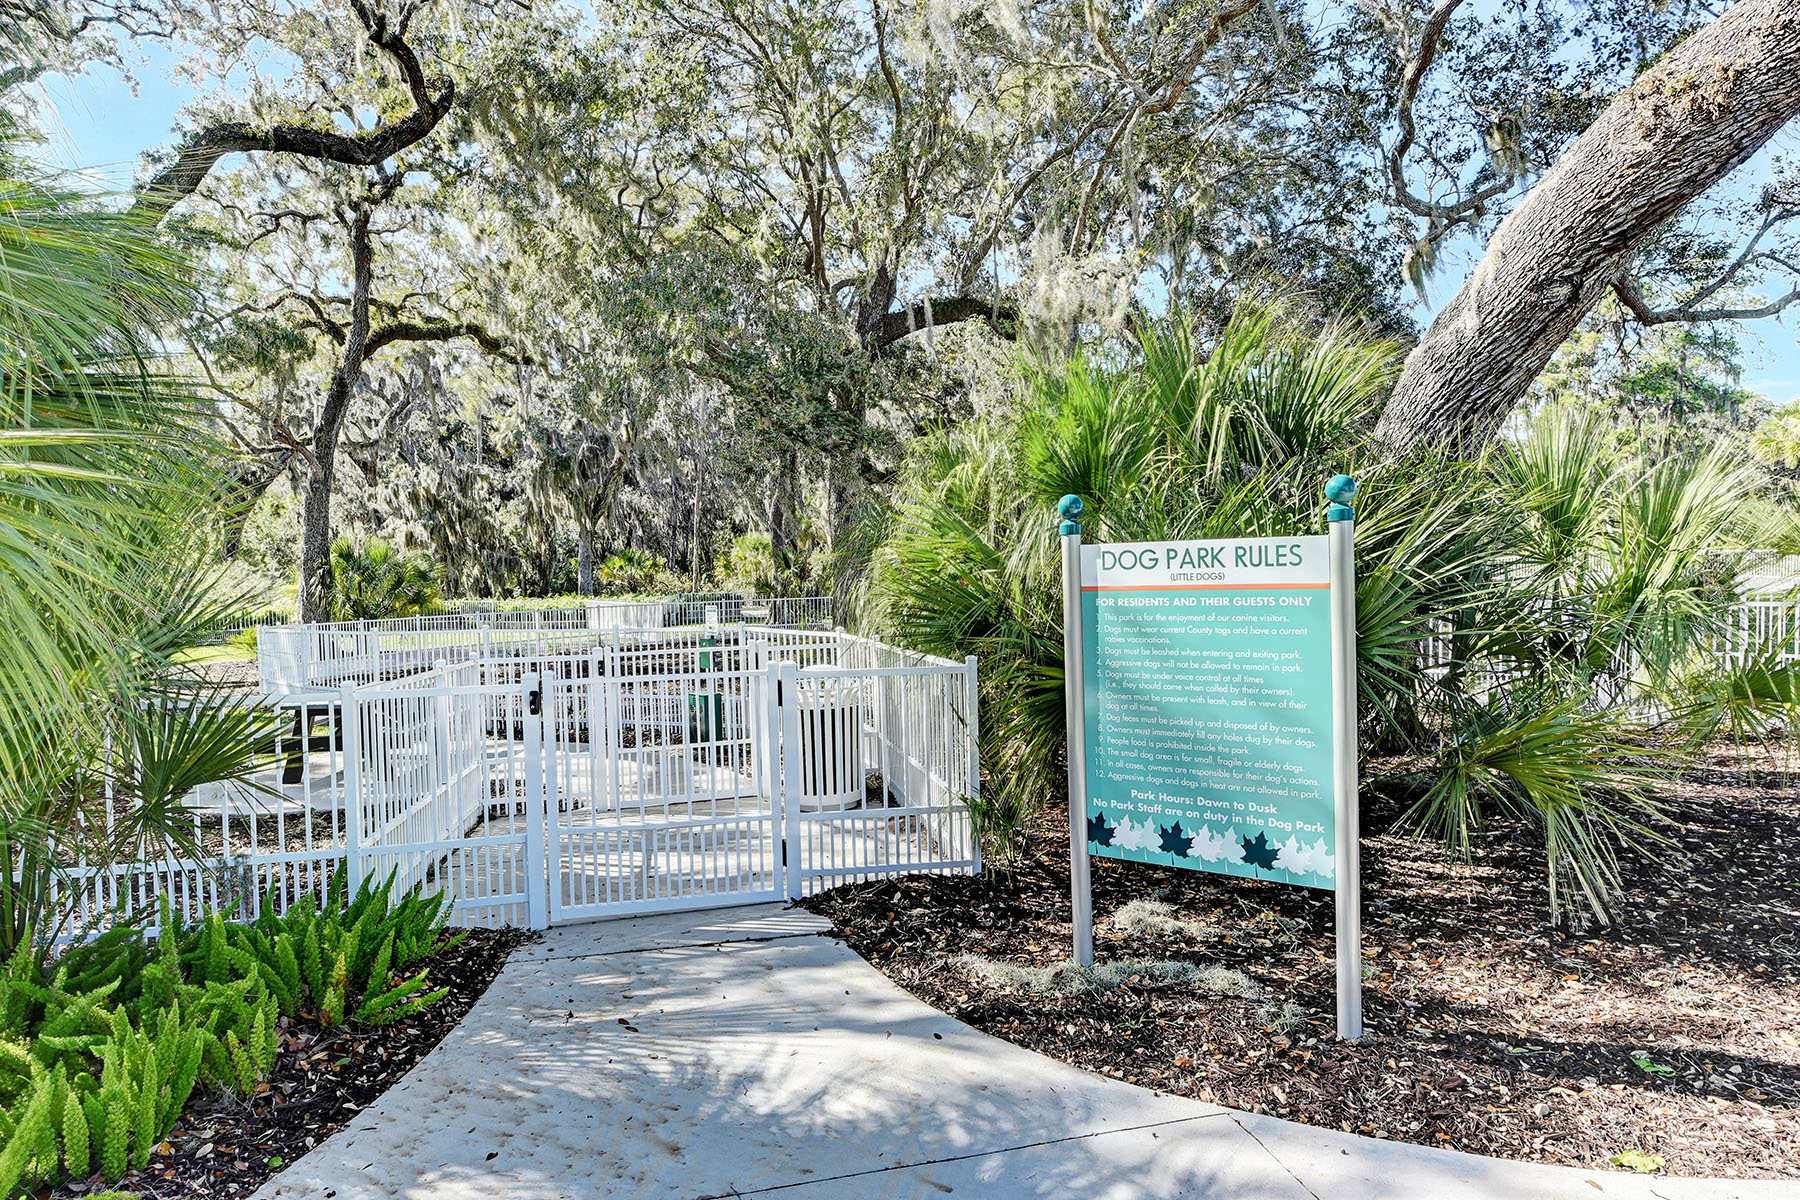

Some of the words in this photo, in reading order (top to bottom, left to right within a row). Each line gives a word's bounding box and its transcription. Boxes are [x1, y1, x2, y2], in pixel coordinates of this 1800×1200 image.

[1101, 548, 1159, 570] DOG
[1166, 546, 1226, 569] PARK
[1234, 544, 1302, 567] RULES
[1170, 572, 1194, 581] (LITTLE
[1195, 571, 1225, 581] DOGS)
[1095, 597, 1114, 606] FOR
[1117, 597, 1170, 606] RESIDENTS
[1172, 597, 1197, 606] AND
[1199, 597, 1230, 606] THEIR
[1232, 597, 1275, 606] GUESTS
[1278, 597, 1312, 606] ONLY
[1104, 612, 1117, 620] This
[1118, 612, 1135, 623] park
[1143, 612, 1154, 620] for
[1155, 612, 1167, 621] the
[1167, 613, 1206, 623] enjoyment
[1207, 613, 1215, 621] of
[1104, 624, 1121, 634] Dogs
[1186, 625, 1213, 636] County
[1214, 627, 1230, 636] tags
[1232, 625, 1248, 634] and
[1249, 626, 1269, 634] have
[1104, 634, 1125, 642] rabies
[1126, 635, 1170, 643] vaccinations.
[1104, 646, 1121, 656] Dogs
[1140, 646, 1150, 655] be
[1151, 647, 1179, 655] leashed
[1180, 648, 1200, 656] when
[1202, 649, 1233, 659] entering
[1234, 649, 1250, 657] and
[1252, 650, 1278, 660] exiting
[1281, 650, 1301, 661] park.
[1104, 657, 1142, 667] Aggressive
[1143, 658, 1160, 669] dogs
[1162, 659, 1174, 667] will
[1189, 660, 1199, 668] be
[1201, 660, 1231, 669] allowed
[1242, 663, 1269, 671] remain
[1272, 663, 1279, 671] in
[1281, 663, 1302, 673] park.
[1104, 669, 1122, 680] Dogs
[1141, 670, 1150, 679] be
[1152, 671, 1172, 679] under
[1174, 672, 1193, 680] voice
[1195, 673, 1220, 681] control
[1231, 674, 1241, 682] all
[1243, 675, 1264, 683] times
[1122, 679, 1137, 690] they
[1138, 680, 1161, 689] should
[1183, 682, 1203, 691] when
[1205, 683, 1228, 692] called
[1229, 684, 1240, 695] by
[1241, 685, 1259, 694] their
[1106, 691, 1132, 700] Owners
[1150, 692, 1160, 701] be
[1161, 696, 1188, 704] present
[1189, 695, 1205, 703] with
[1207, 695, 1229, 706] leash,
[1231, 697, 1246, 706] and
[1248, 698, 1256, 706] in
[1257, 699, 1277, 707] view
[1278, 699, 1287, 708] of
[1288, 700, 1307, 709] their
[1106, 700, 1119, 711] dog
[1129, 702, 1137, 710] all
[1139, 703, 1159, 712] times.
[1106, 712, 1120, 723] Dog
[1122, 713, 1139, 722] feces
[1158, 715, 1168, 724] be
[1169, 717, 1193, 727] picked
[1194, 720, 1204, 729] up
[1206, 719, 1221, 727] and
[1223, 719, 1257, 731] disposed
[1259, 722, 1267, 730] of
[1269, 722, 1280, 734] by
[1106, 724, 1133, 733] Owners
[1151, 727, 1195, 740] immediately
[1196, 730, 1205, 739] fill
[1206, 733, 1221, 742] any
[1223, 732, 1243, 741] holes
[1244, 733, 1260, 745] dug
[1262, 734, 1273, 746] by
[1274, 736, 1293, 745] their
[1294, 737, 1317, 748] dogs.
[1106, 735, 1129, 746] People
[1130, 736, 1146, 746] food
[1148, 738, 1154, 746] is
[1155, 739, 1192, 750] prohibited
[1194, 742, 1216, 752] inside
[1217, 744, 1229, 753] the
[1107, 747, 1119, 755] The
[1120, 749, 1138, 757] small
[1139, 749, 1153, 761] dog
[1173, 753, 1180, 761] is
[1181, 753, 1192, 762] for
[1193, 755, 1215, 765] small,
[1217, 756, 1242, 768] fragile
[1254, 759, 1281, 772] elderly
[1114, 759, 1123, 767] all
[1125, 762, 1146, 771] cases,
[1147, 764, 1173, 772] owners
[1188, 768, 1230, 778] responsible
[1232, 770, 1243, 779] for
[1245, 771, 1263, 781] their
[1288, 777, 1320, 786] actions.
[1107, 770, 1144, 781] Aggressive
[1145, 773, 1163, 785] dogs
[1164, 776, 1179, 785] and
[1180, 777, 1198, 788] dogs
[1200, 779, 1207, 787] in
[1209, 779, 1226, 789] heat
[1257, 785, 1288, 796] allowed
[1290, 788, 1298, 796] in
[1300, 790, 1321, 800] park.
[1130, 789, 1155, 800] Park
[1158, 792, 1193, 804] Hours:
[1196, 796, 1230, 808] Dawn
[1232, 801, 1245, 810] to
[1248, 802, 1277, 814] Dusk
[1092, 797, 1108, 807] No
[1110, 799, 1134, 810] Park
[1137, 802, 1162, 814] Staff
[1164, 808, 1183, 816] are
[1185, 810, 1200, 818] on
[1202, 809, 1228, 824] duty
[1231, 813, 1242, 823] in
[1245, 815, 1264, 826] the
[1267, 817, 1292, 832] Dog
[1295, 821, 1325, 833] Park
